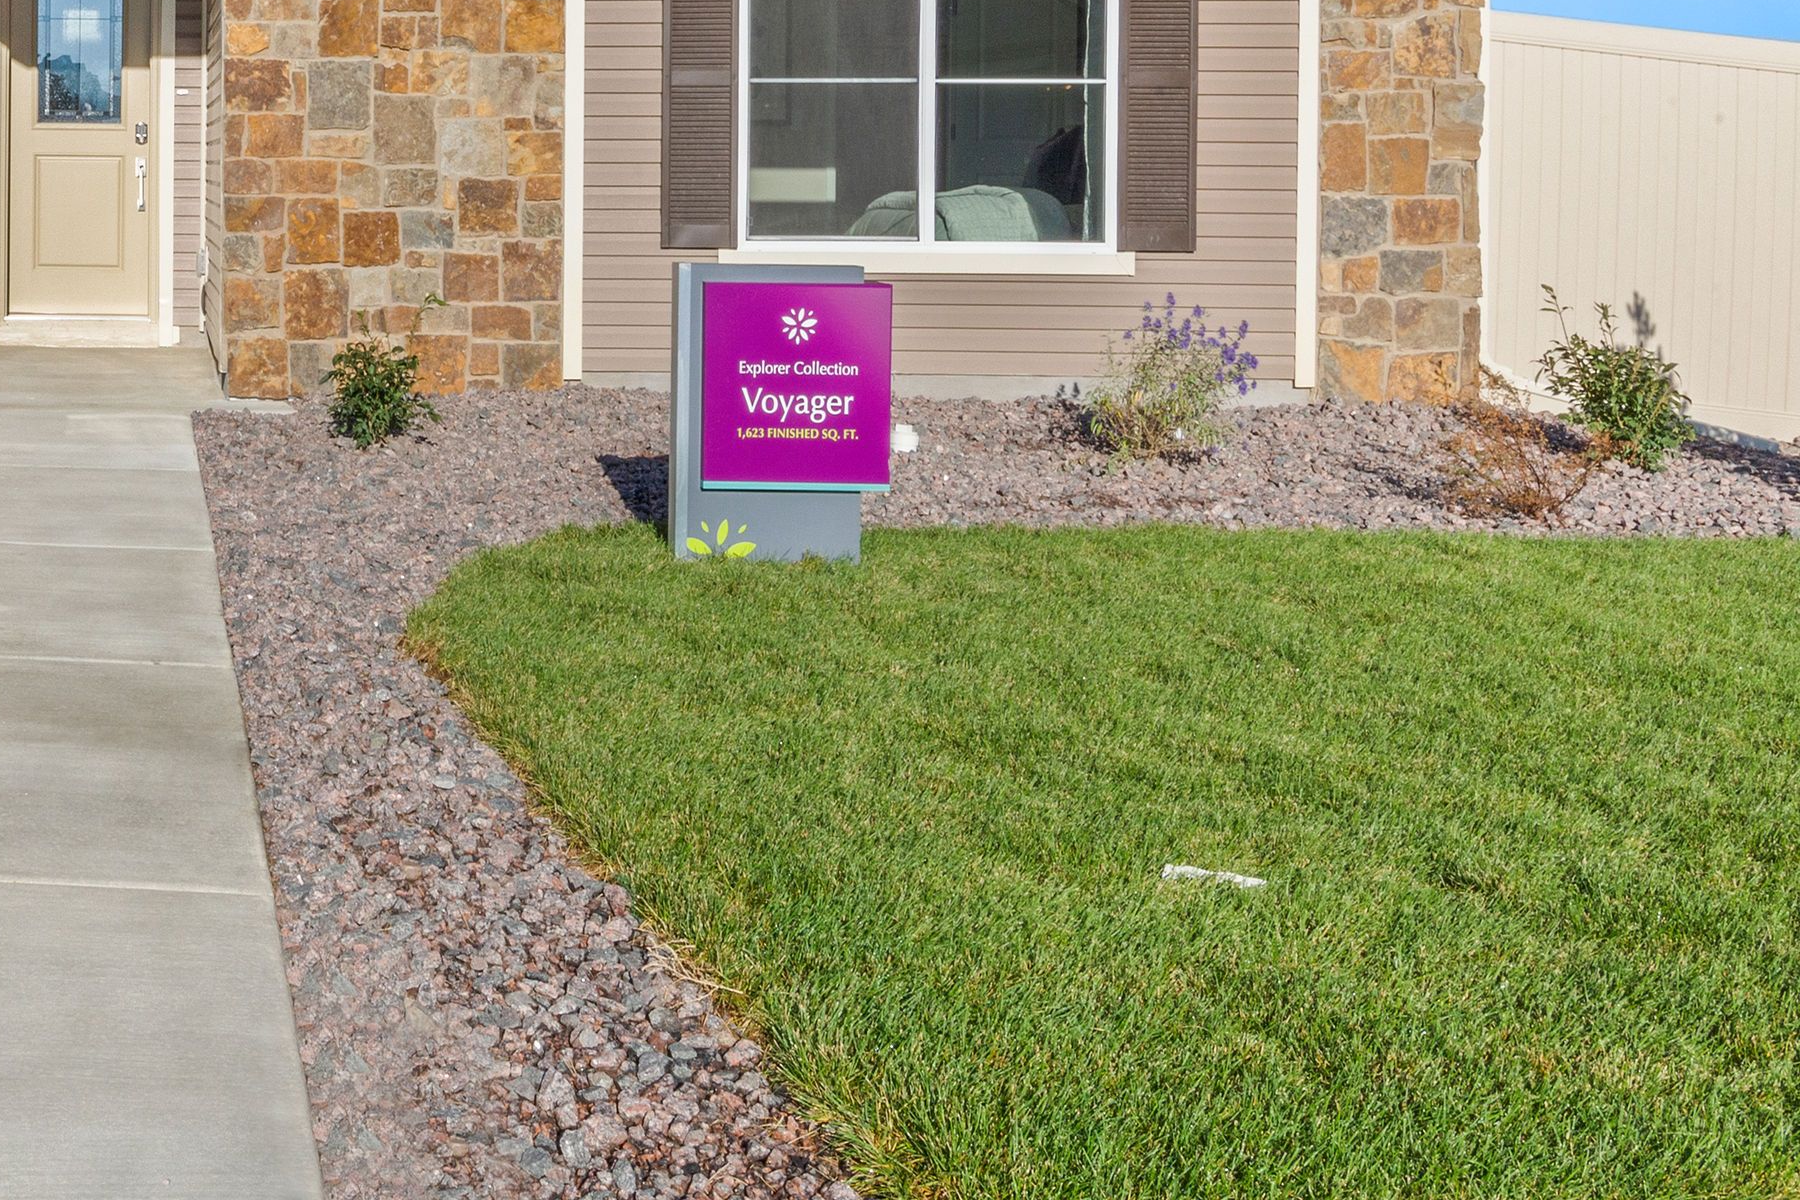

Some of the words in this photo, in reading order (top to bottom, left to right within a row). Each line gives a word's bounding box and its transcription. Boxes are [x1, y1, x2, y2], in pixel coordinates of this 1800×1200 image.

[739, 360, 791, 378] Explorer
[793, 361, 859, 376] Collection
[741, 386, 855, 423] Voyager
[737, 427, 764, 439] 1,623
[767, 428, 819, 439] FINISHED
[822, 428, 841, 441] SQ.
[843, 429, 859, 440] FT.
